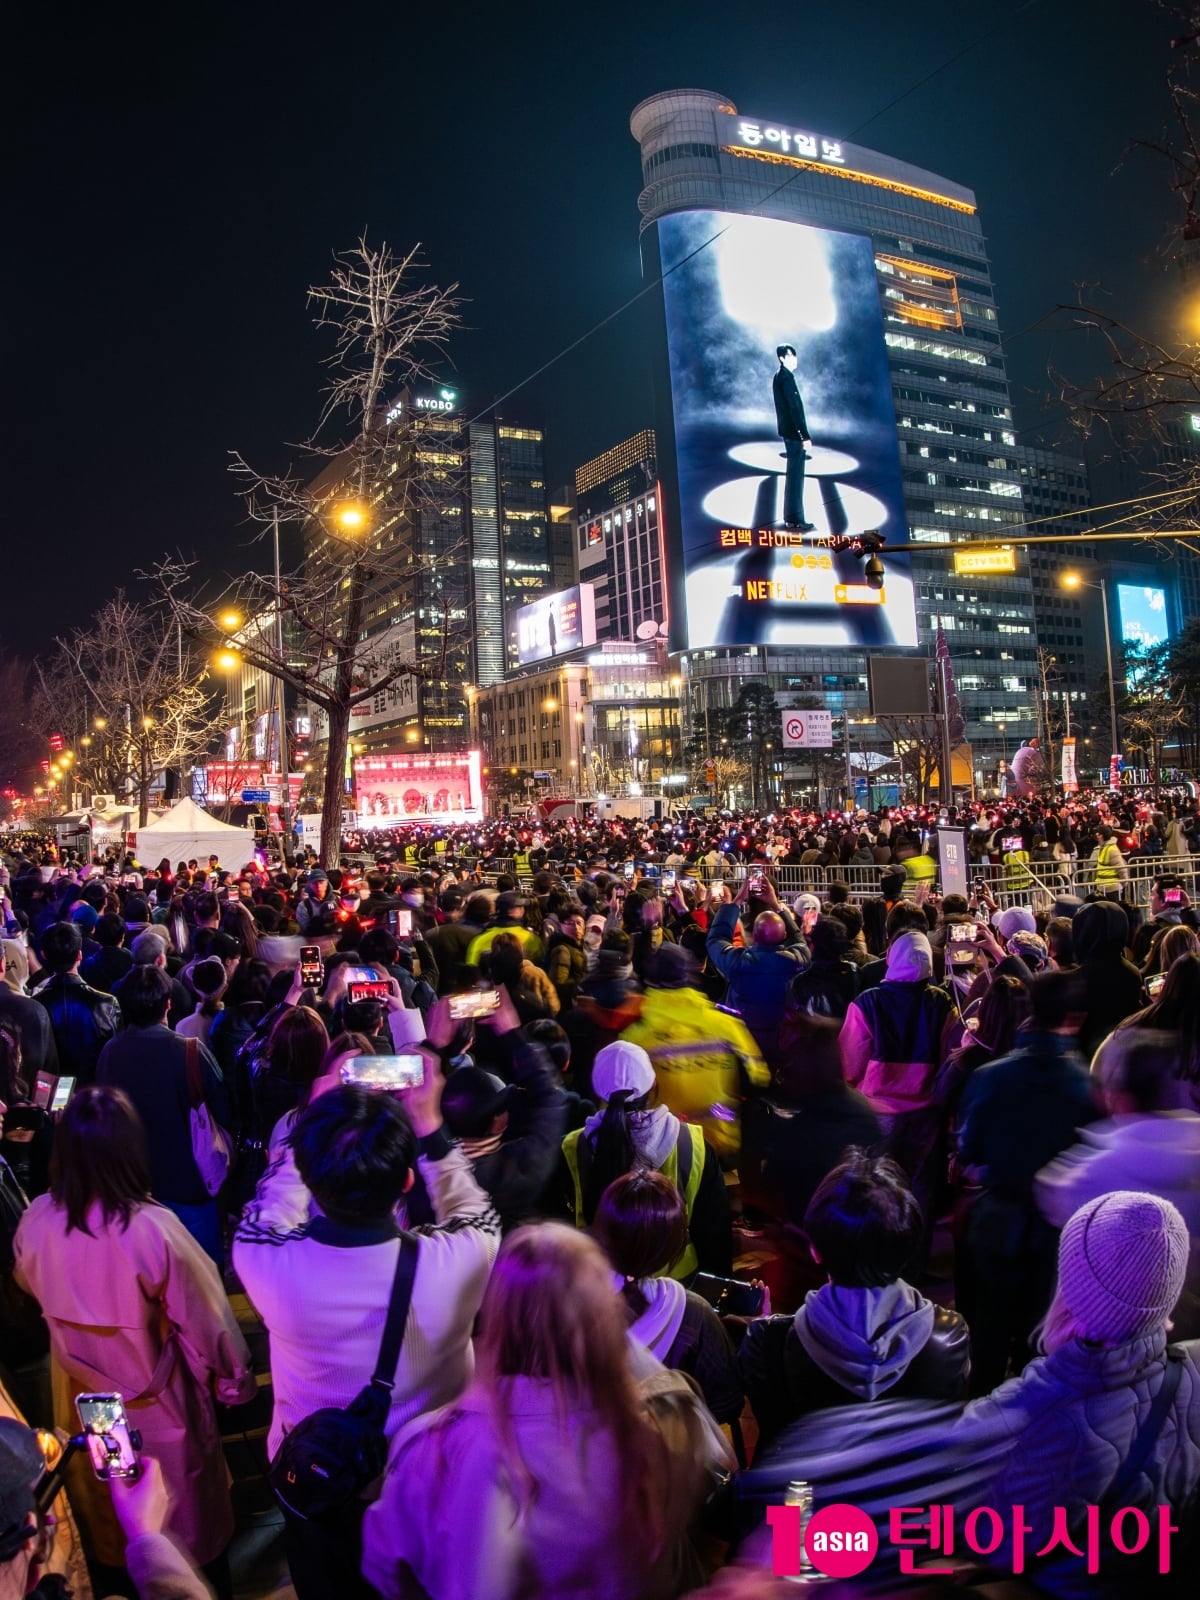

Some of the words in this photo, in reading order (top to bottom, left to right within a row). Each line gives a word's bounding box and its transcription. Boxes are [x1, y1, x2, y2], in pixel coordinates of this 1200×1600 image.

[738, 121, 845, 164] 동아일보
[416, 398, 453, 411] KYOBO
[720, 529, 752, 546] 컴백
[758, 530, 803, 548] 라이브
[746, 580, 808, 601] NETFLIX
